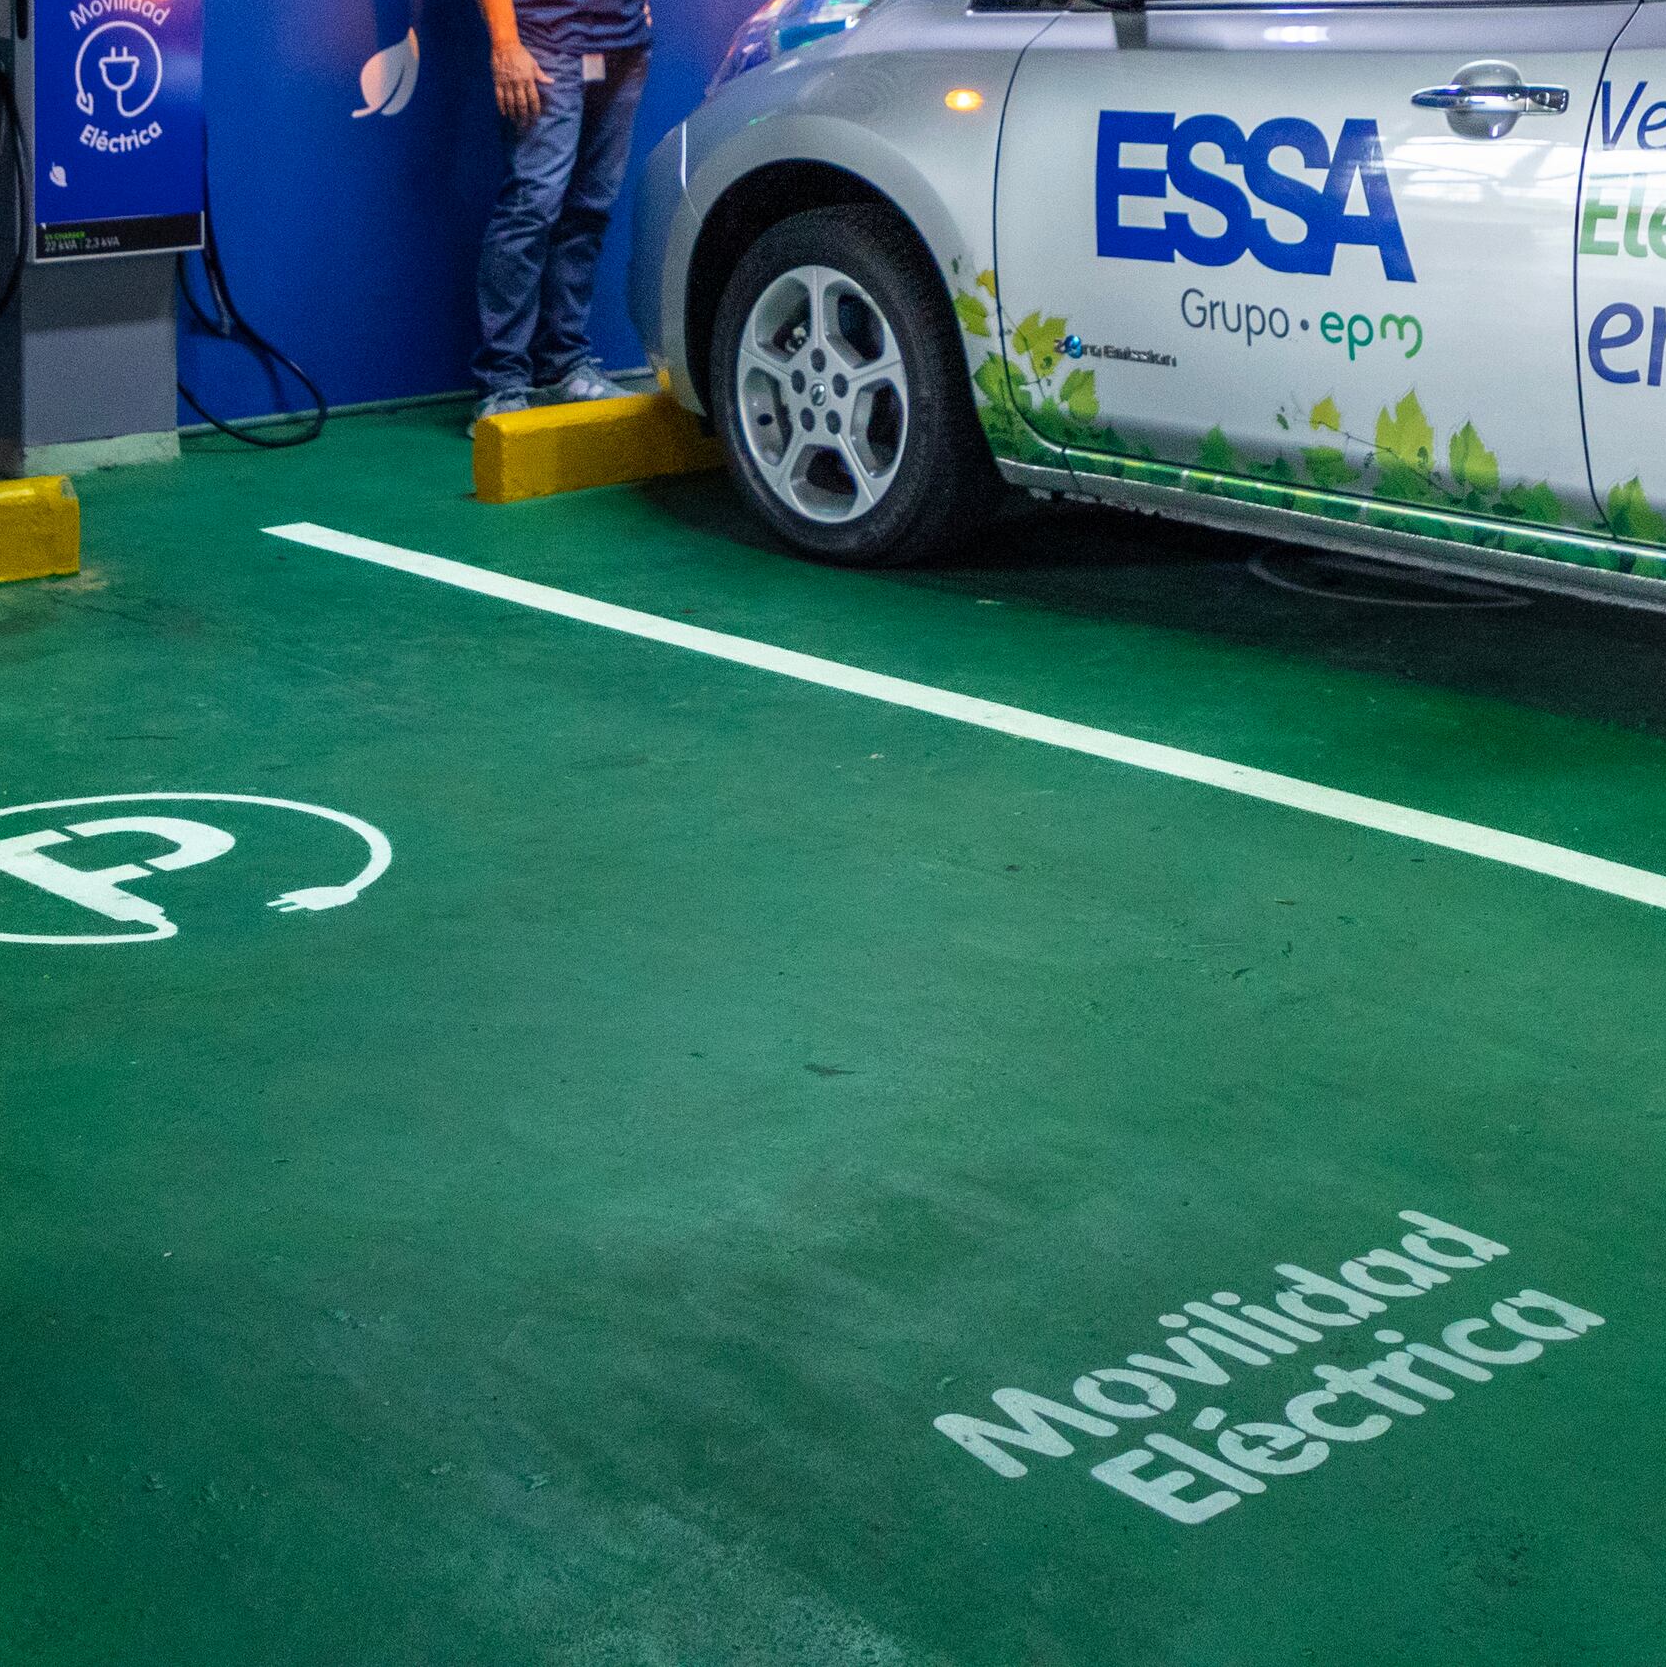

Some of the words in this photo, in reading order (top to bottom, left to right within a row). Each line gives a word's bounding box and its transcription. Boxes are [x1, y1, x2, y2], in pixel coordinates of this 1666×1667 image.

[79, 120, 163, 153] Eléctrica
[1095, 109, 1418, 283] ESSA
[1181, 288, 1290, 346] Grupo
[1320, 311, 1423, 361] epm
[933, 1209, 1511, 1479] Movilidad
[1090, 1288, 1606, 1525] Eléctrica
